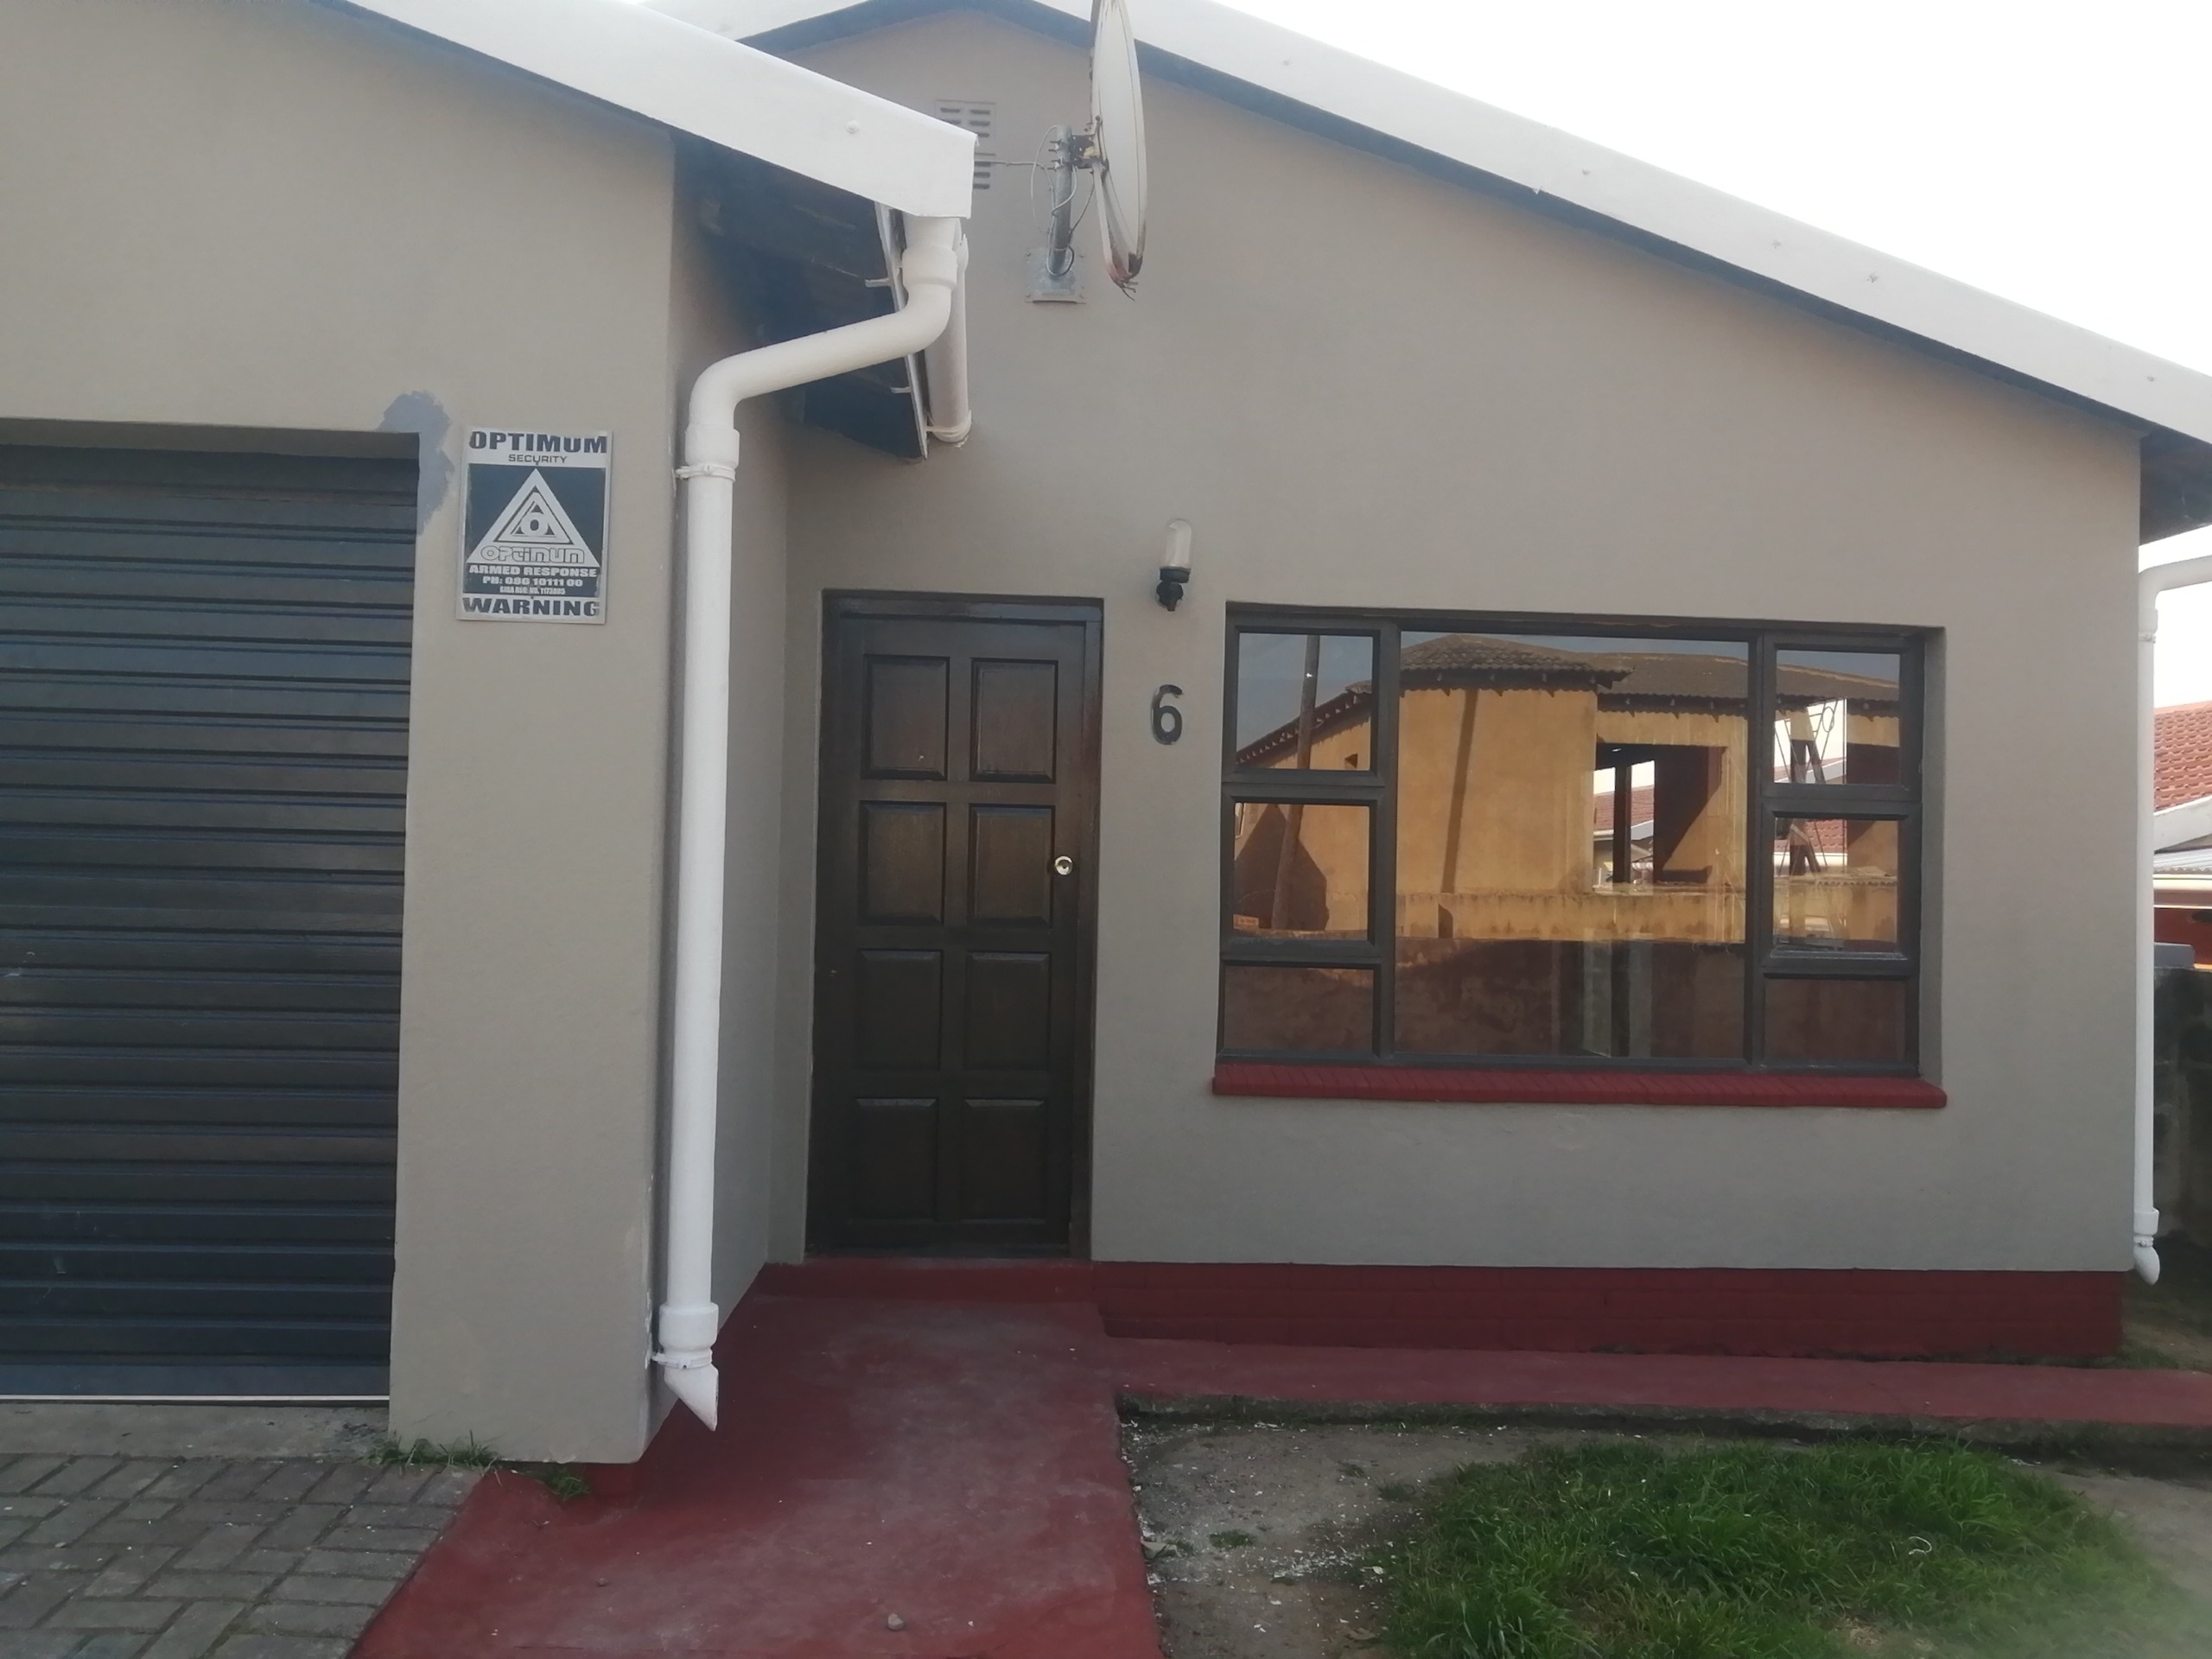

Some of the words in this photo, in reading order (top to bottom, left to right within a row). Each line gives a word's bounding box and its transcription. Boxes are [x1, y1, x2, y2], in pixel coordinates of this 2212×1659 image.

[469, 431, 607, 454] OPTIMUM
[508, 454, 568, 464] SECURITY
[469, 564, 520, 575] ARMED
[524, 567, 598, 577] RESPONSE
[505, 576, 531, 585] 086
[532, 578, 565, 587] 10111
[462, 597, 600, 617] WARNING
[1150, 684, 1183, 745] 6
